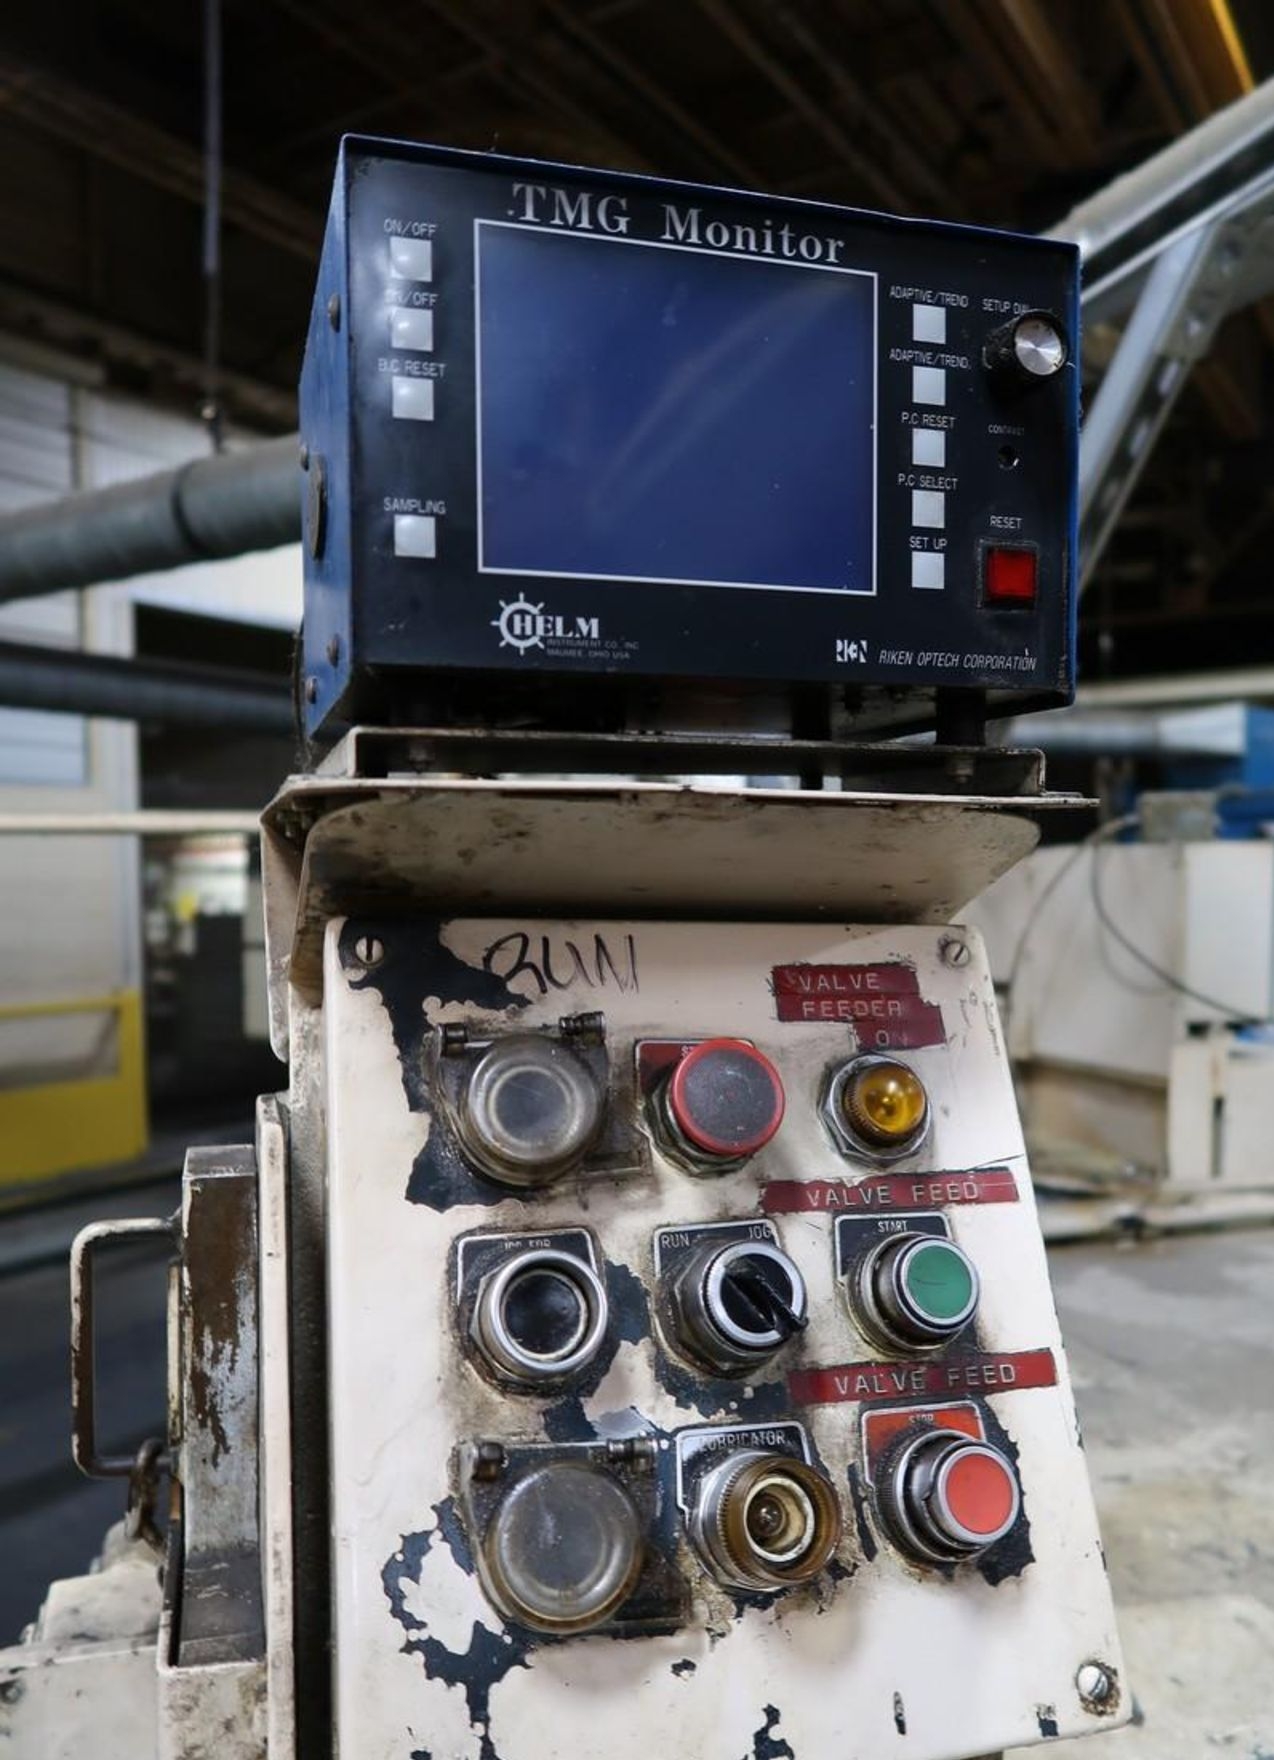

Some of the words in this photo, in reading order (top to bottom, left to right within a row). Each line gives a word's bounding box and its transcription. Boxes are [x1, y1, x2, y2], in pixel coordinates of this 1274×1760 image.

[384, 218, 437, 237] ON/OFF
[512, 183, 631, 234] TMG
[661, 204, 845, 263] Monitor
[890, 285, 969, 308] ADAPTIVE/TREND
[982, 298, 1011, 313] SETUP
[404, 360, 446, 378] RESET
[902, 412, 919, 426] P.C
[923, 414, 956, 429] RESET
[898, 473, 916, 487] P.C
[919, 475, 958, 490] SELECT
[383, 497, 446, 515] SAMPLING
[990, 515, 1023, 530] RESET
[909, 536, 928, 549] SET
[933, 537, 948, 551] UP
[512, 614, 599, 639] HELM
[879, 650, 914, 665] RIKEN
[916, 652, 960, 668] OPTECH
[963, 654, 1038, 671] CORPORATION
[799, 972, 881, 992] VALVE
[802, 1000, 903, 1019] FEEDER
[806, 1184, 893, 1207] VALVE
[911, 1181, 980, 1202] FEED
[661, 1233, 690, 1249] RUN
[833, 1369, 928, 1397] VALVE
[947, 1363, 1016, 1386] FEED
